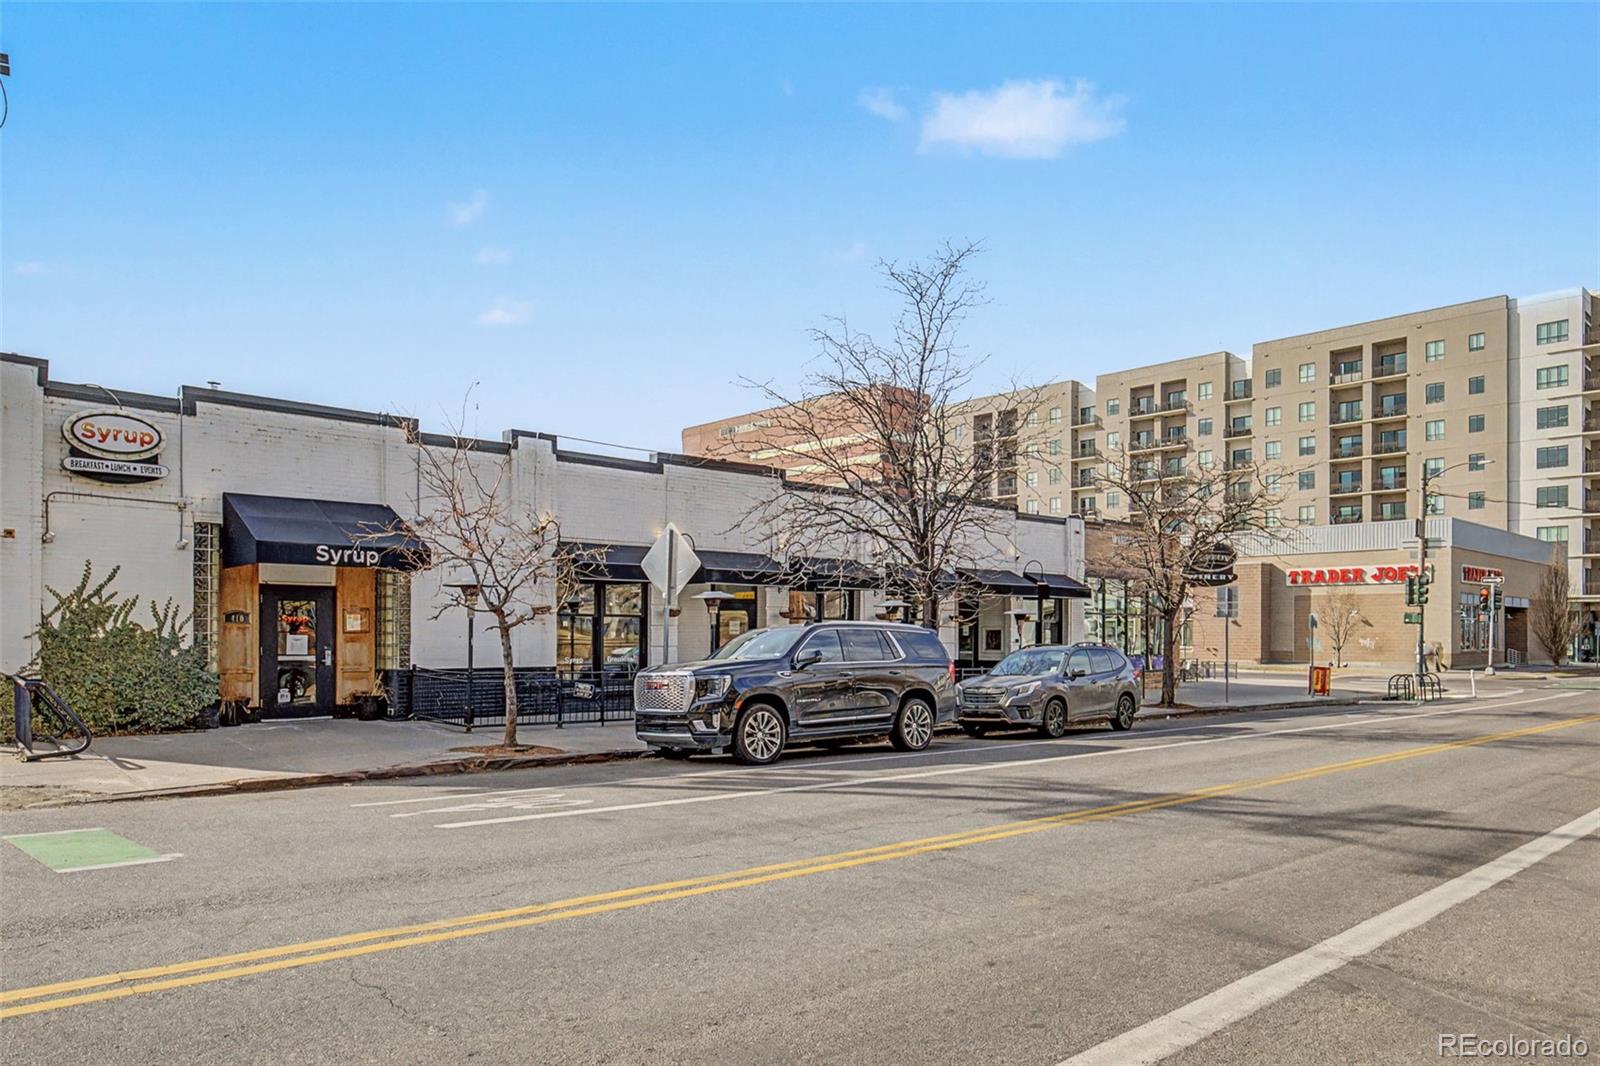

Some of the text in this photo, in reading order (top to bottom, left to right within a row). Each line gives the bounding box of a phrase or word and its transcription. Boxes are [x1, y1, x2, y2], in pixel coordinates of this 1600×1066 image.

[81, 421, 155, 448] Syrup
[70, 459, 163, 476] BREAKFAST LUNCH EVENTS
[316, 544, 379, 567] Syrup
[1188, 573, 1234, 581] WINERY
[1287, 564, 1429, 585] TRADER JOE'
[281, 614, 310, 626] Syrup
